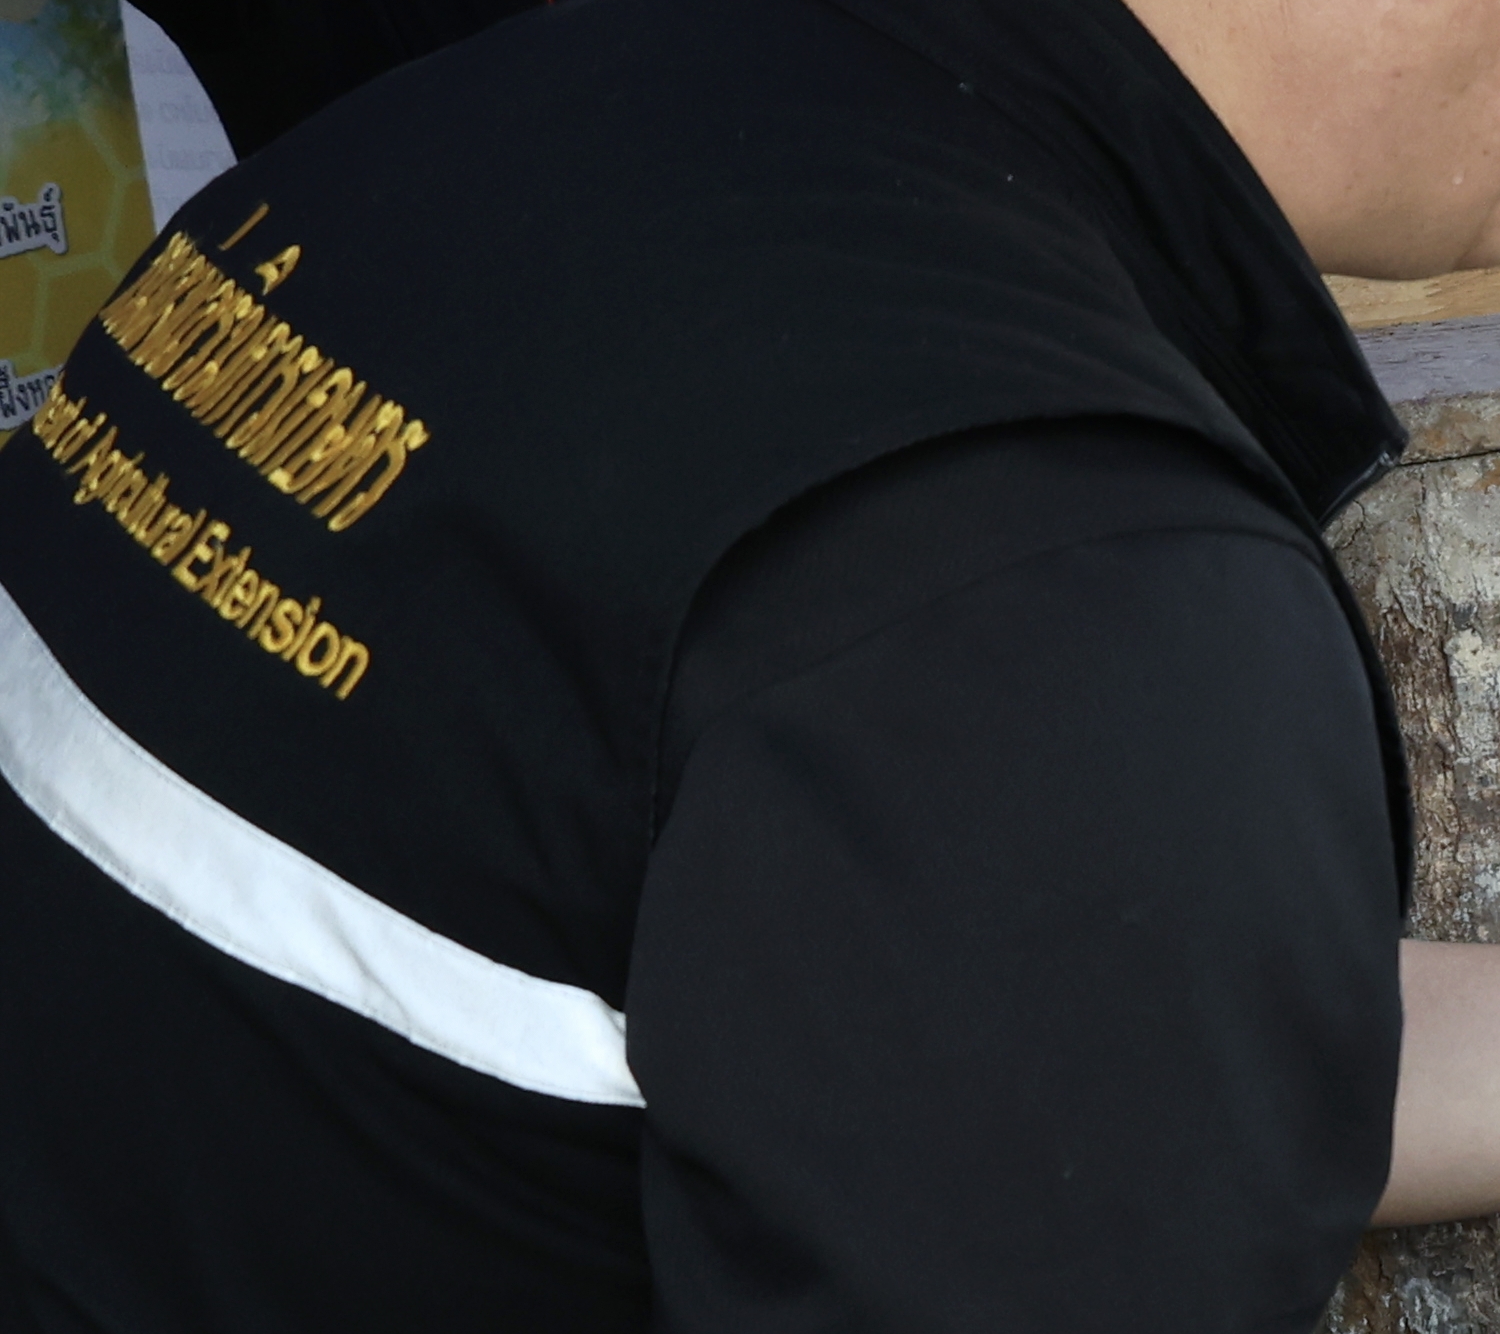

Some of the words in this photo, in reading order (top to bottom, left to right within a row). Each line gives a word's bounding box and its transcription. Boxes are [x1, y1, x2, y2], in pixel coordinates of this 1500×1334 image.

[0, 187, 58, 246] พันธุ์
[170, 519, 371, 701] Extension
